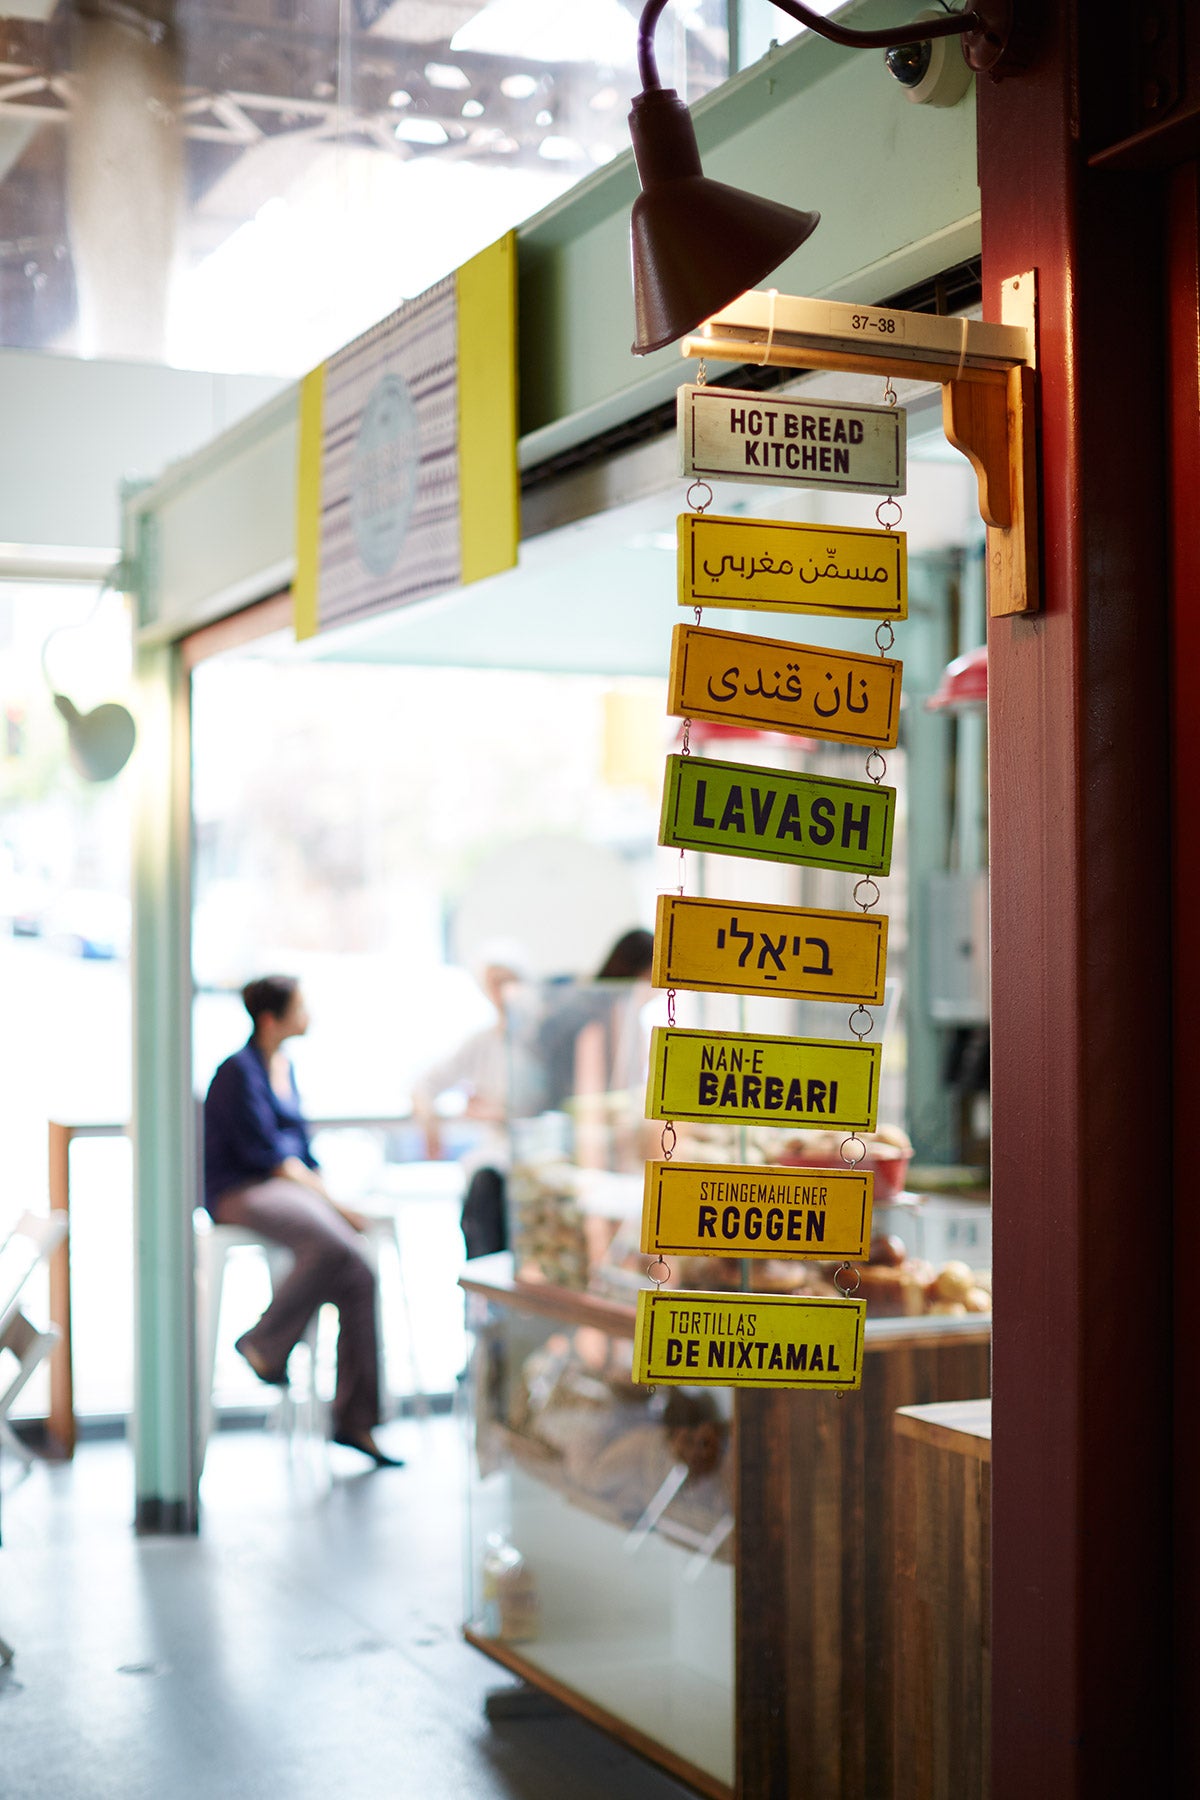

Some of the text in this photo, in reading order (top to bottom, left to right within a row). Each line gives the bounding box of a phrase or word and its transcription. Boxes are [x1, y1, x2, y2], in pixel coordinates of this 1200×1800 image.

[730, 409, 863, 444] HOT BREAD
[745, 441, 849, 473] KITCHEN
[704, 552, 793, 582] مغربي
[814, 672, 868, 717] نان
[693, 780, 870, 850] LAVASH
[701, 1046, 764, 1074] NAN-E
[698, 1072, 838, 1113] BARBARI
[701, 1182, 827, 1205] STEINGEMAHLENER
[698, 1206, 825, 1241] ROGGEN
[670, 1311, 756, 1336] TORTILLAS
[666, 1339, 839, 1371] DE NIXTAMAL
